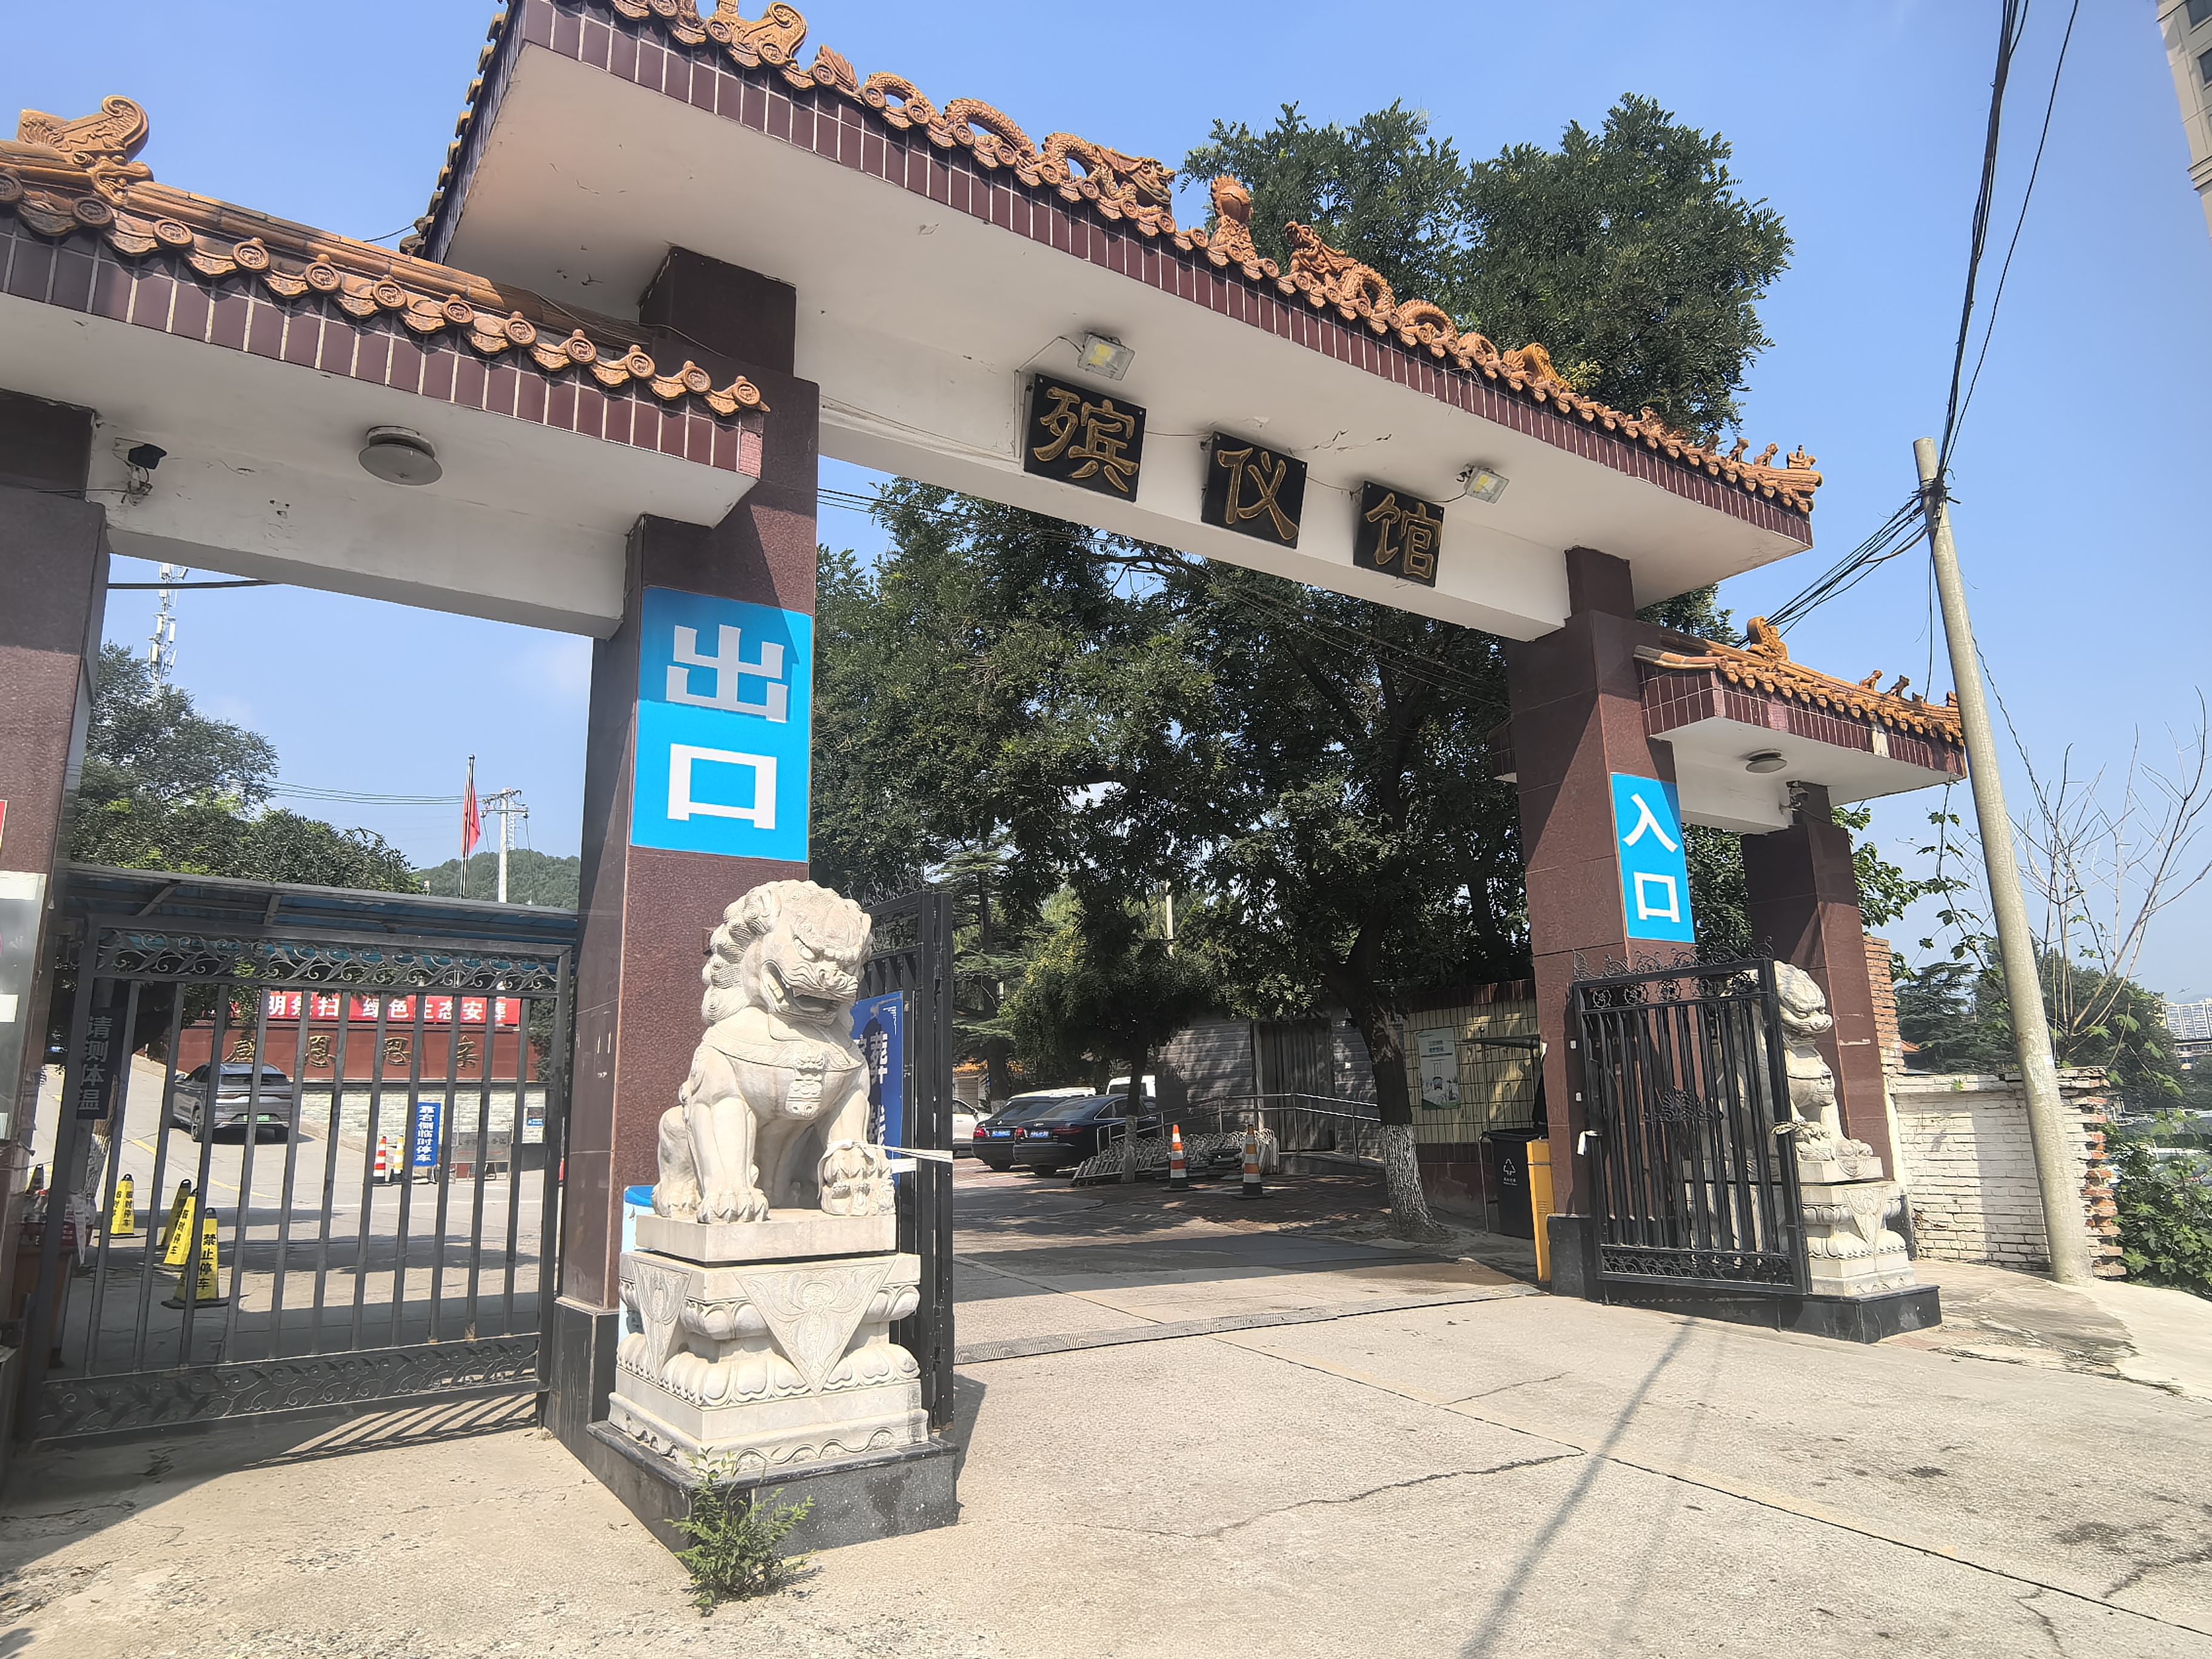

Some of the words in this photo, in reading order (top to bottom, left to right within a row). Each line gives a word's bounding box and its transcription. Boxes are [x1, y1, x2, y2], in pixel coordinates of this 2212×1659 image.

[1033, 386, 1443, 579] 殡仪馆
[666, 624, 788, 830] 出口
[1622, 793, 1679, 922] 入口
[78, 1016, 113, 1110] 请测体温
[416, 1105, 436, 1161] 靠右侧临时停车
[196, 1234, 216, 1290] 禁止停车
